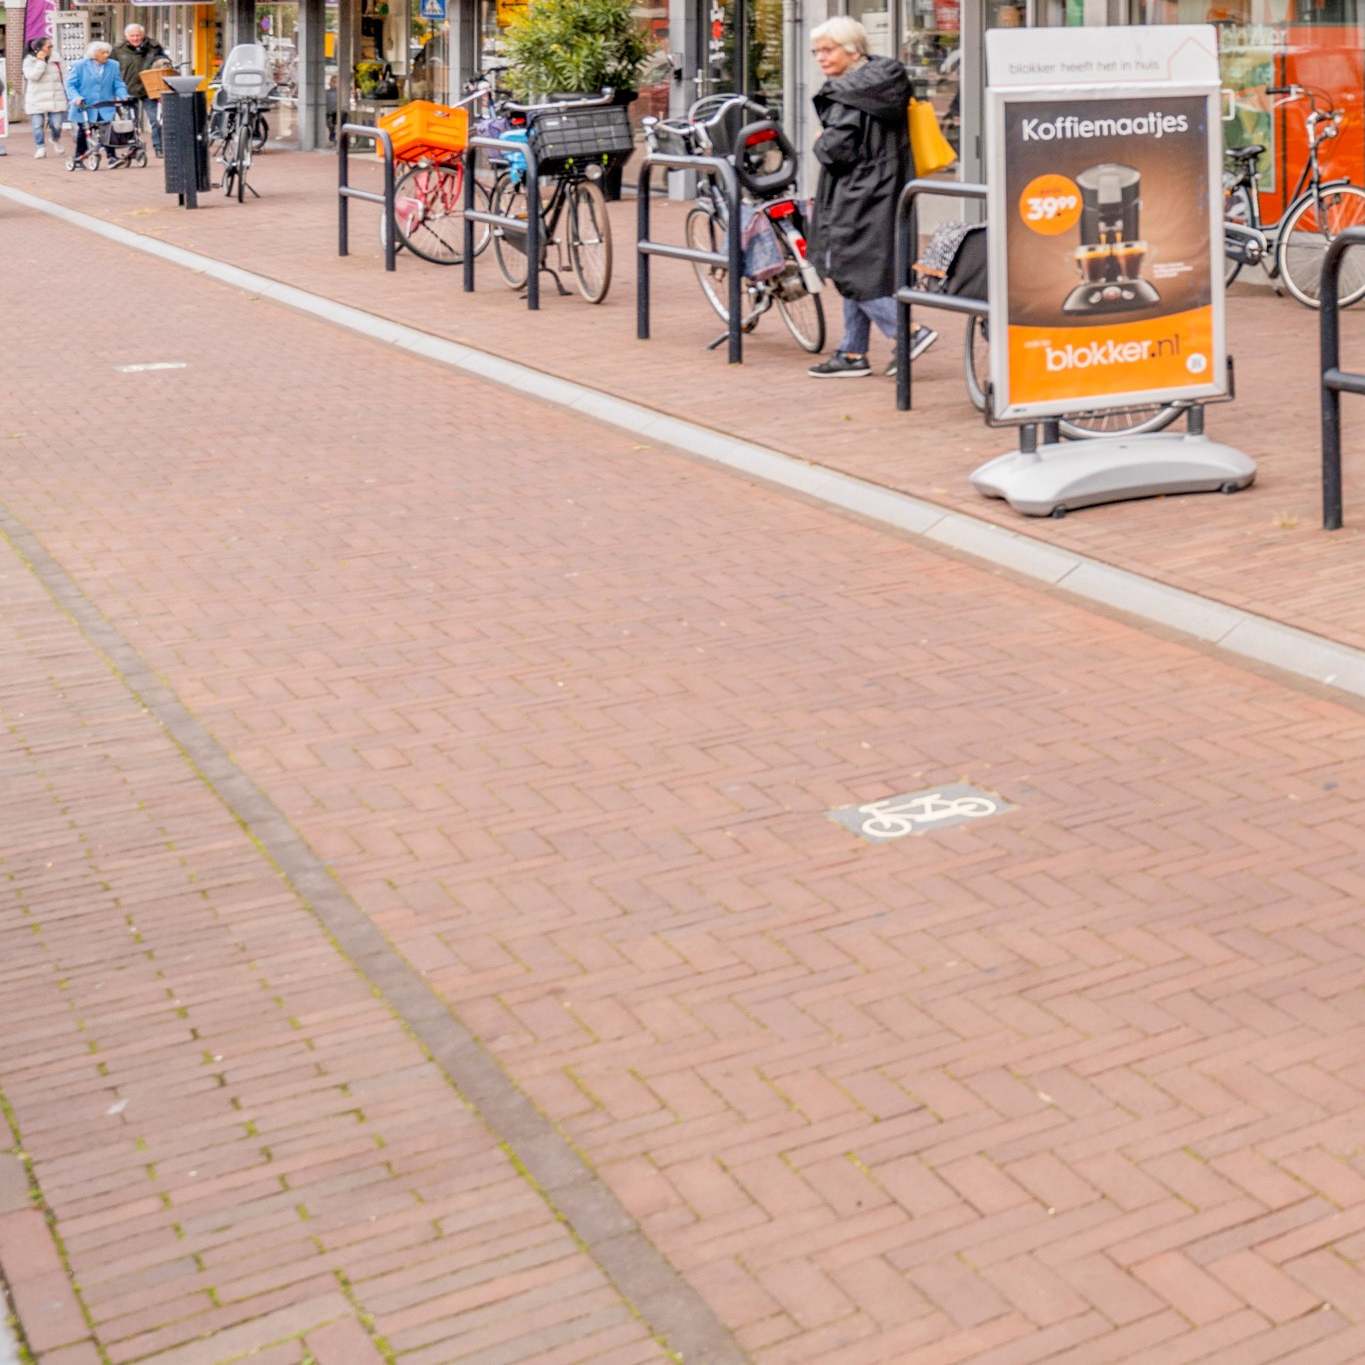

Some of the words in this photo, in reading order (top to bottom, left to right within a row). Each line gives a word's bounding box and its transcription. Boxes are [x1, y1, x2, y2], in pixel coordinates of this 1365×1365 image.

[1008, 64, 1056, 75] blokker
[1060, 61, 1093, 73] heeft
[1096, 60, 1118, 72] het
[1120, 60, 1133, 71] in
[1022, 112, 1189, 142] Koffiemaatjes
[1045, 334, 1180, 372] blokker.nl
